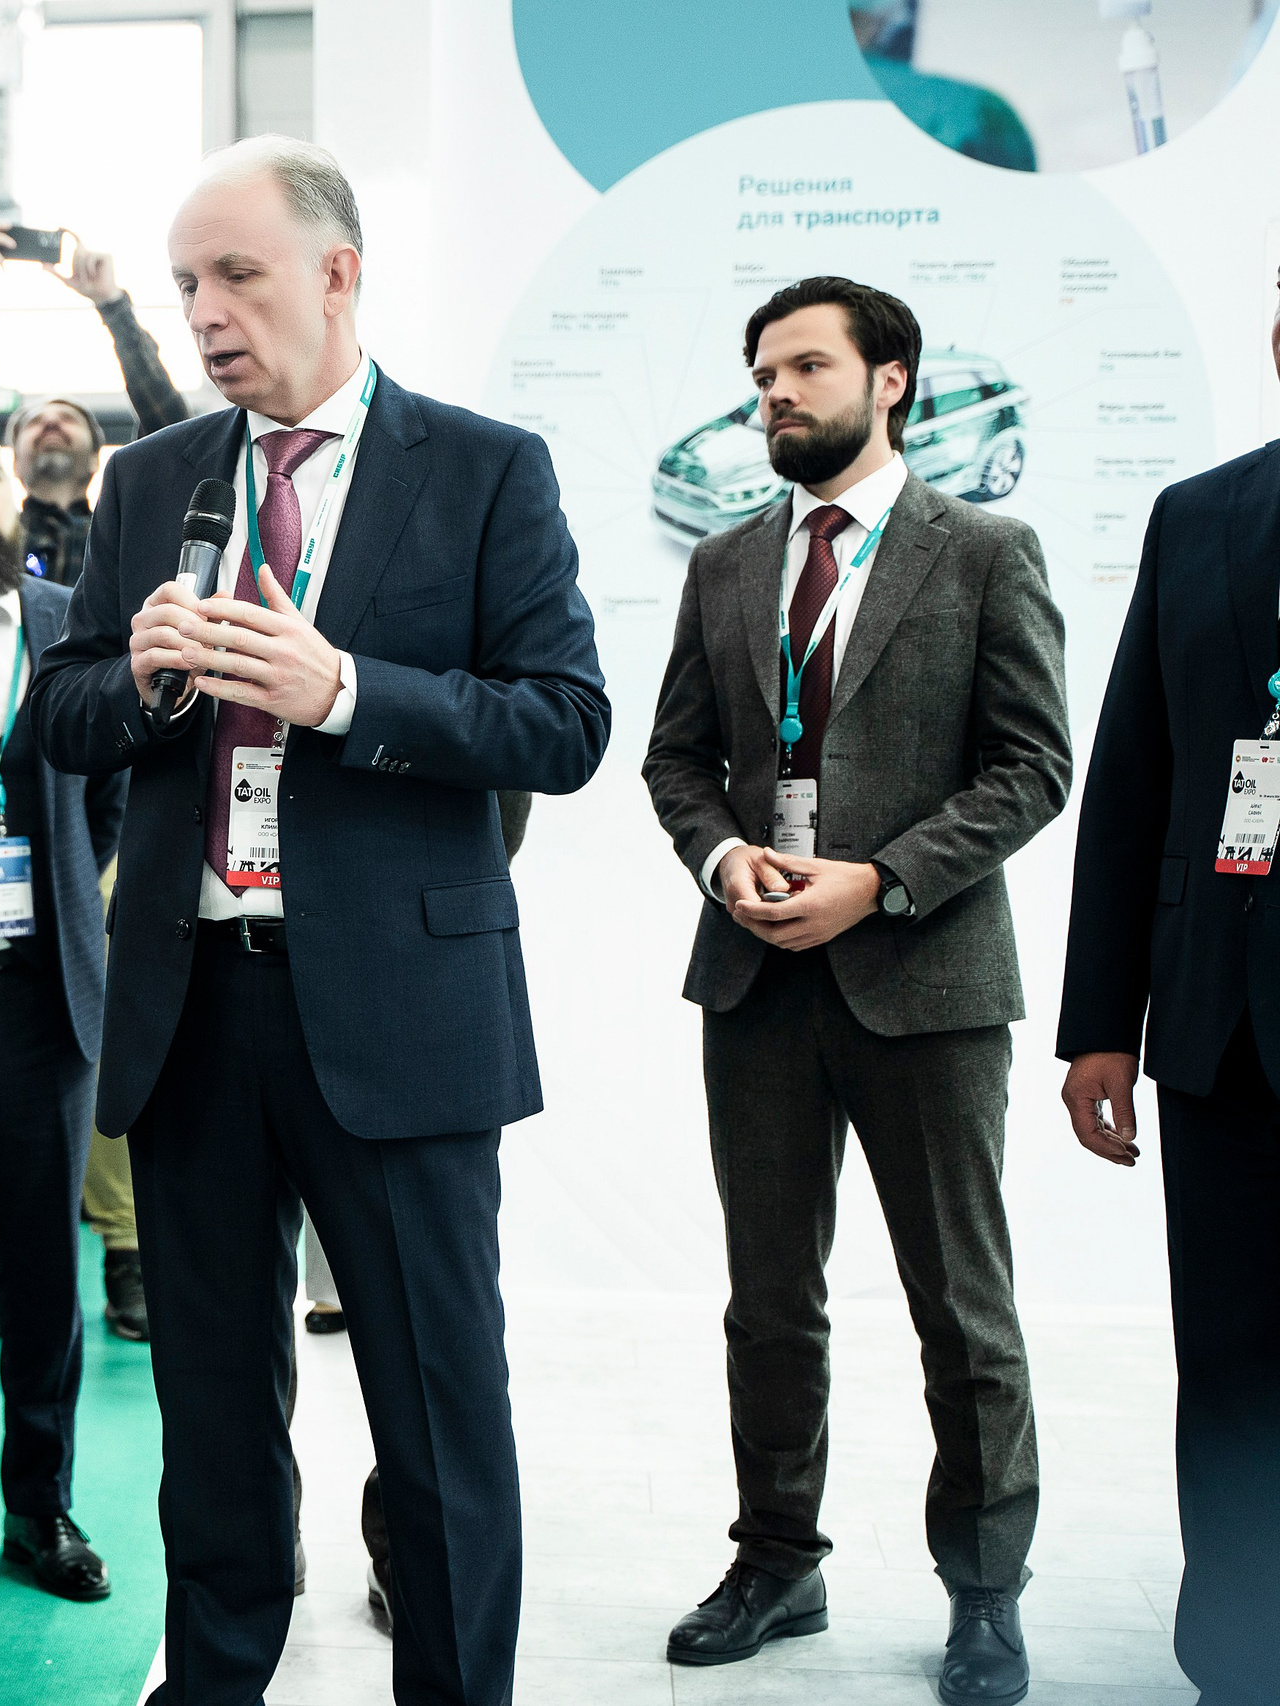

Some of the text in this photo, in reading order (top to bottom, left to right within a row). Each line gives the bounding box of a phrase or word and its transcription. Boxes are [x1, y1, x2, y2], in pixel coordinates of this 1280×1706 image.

[738, 175, 853, 195] Решения
[737, 207, 940, 231] для транспорта
[332, 453, 346, 478] СИБУР
[303, 538, 316, 564] СИБУР
[236, 787, 271, 797] TAT OIL
[1236, 862, 1248, 872] VIP
[261, 875, 280, 886] VIP
